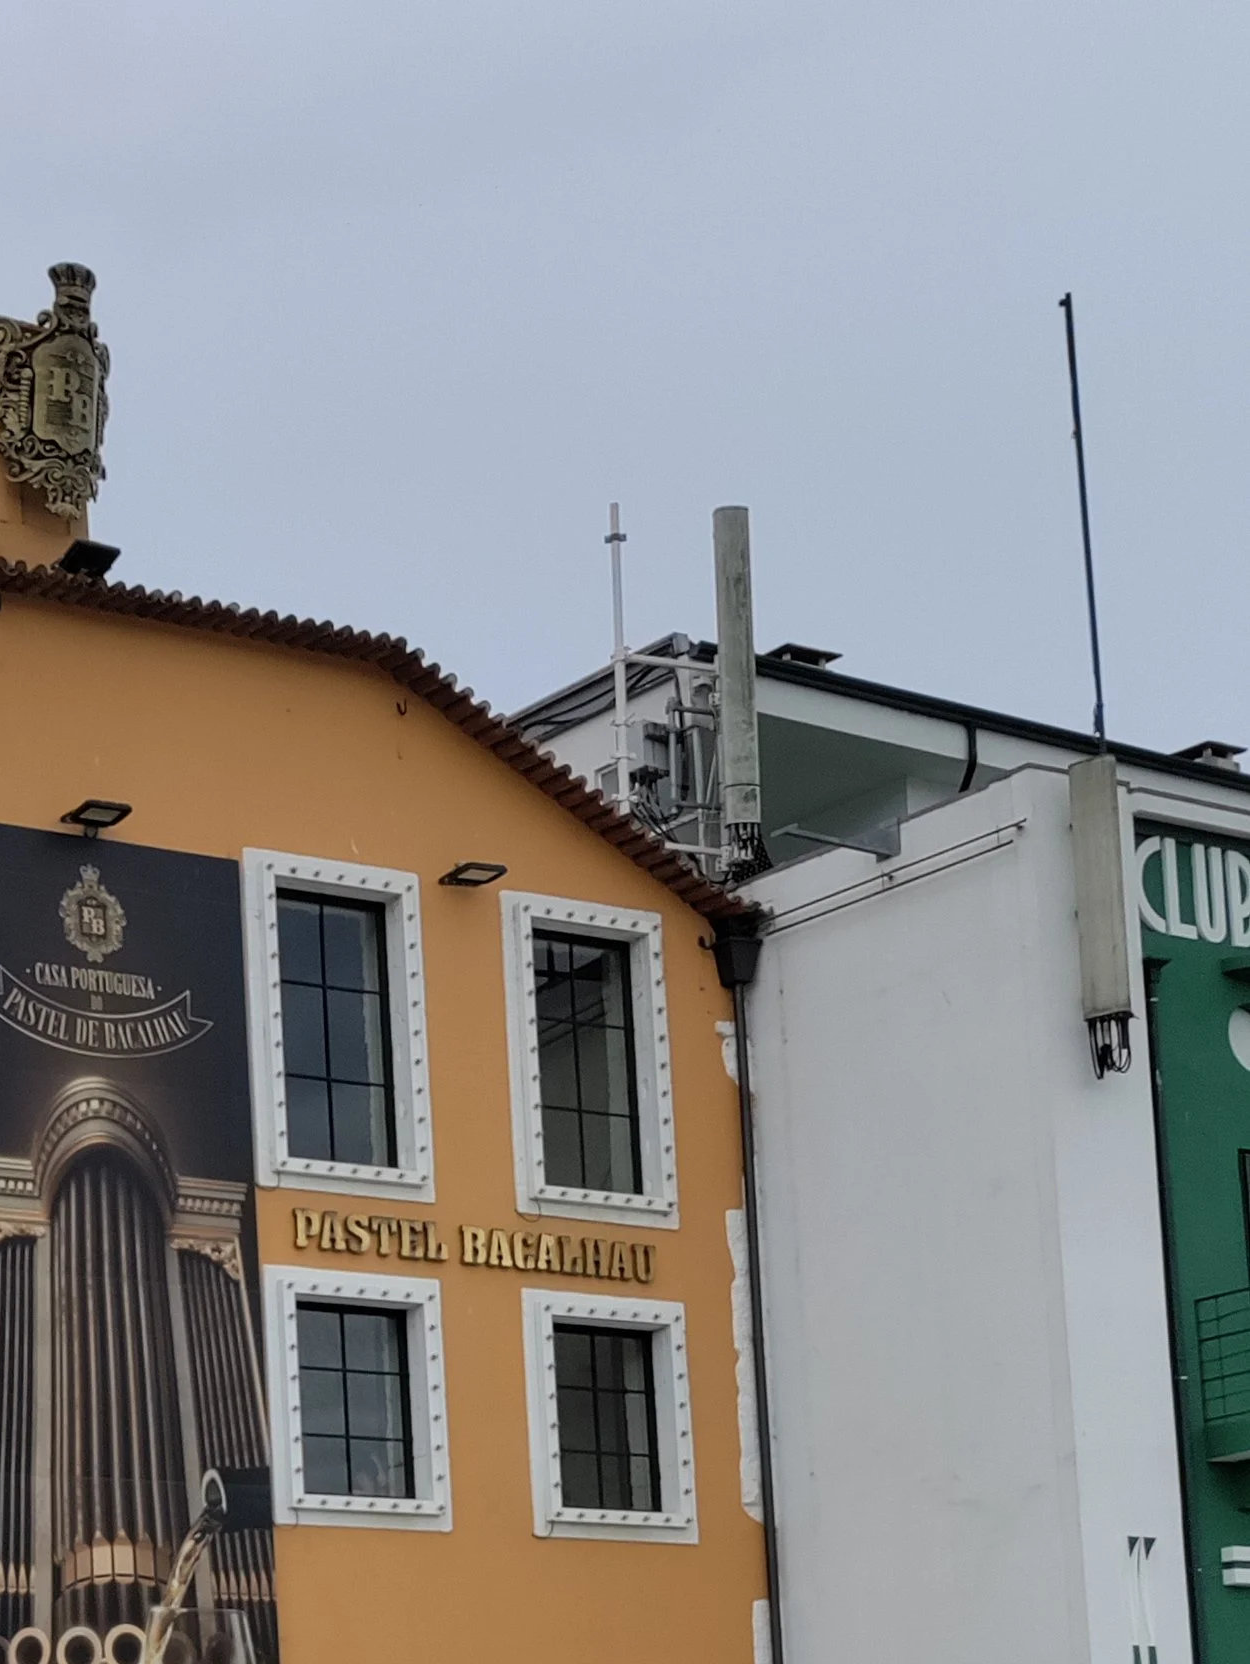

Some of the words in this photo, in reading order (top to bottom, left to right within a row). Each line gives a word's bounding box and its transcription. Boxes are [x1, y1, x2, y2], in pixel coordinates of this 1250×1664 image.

[34, 962, 68, 988] CASA
[70, 966, 155, 1000] PORTUGUESA
[2, 987, 70, 1041] PASTEL
[75, 1017, 99, 1048] DE
[104, 1008, 190, 1050] BACALHAU
[293, 1208, 449, 1261] PASTEL
[460, 1225, 657, 1283] BACALHAU
